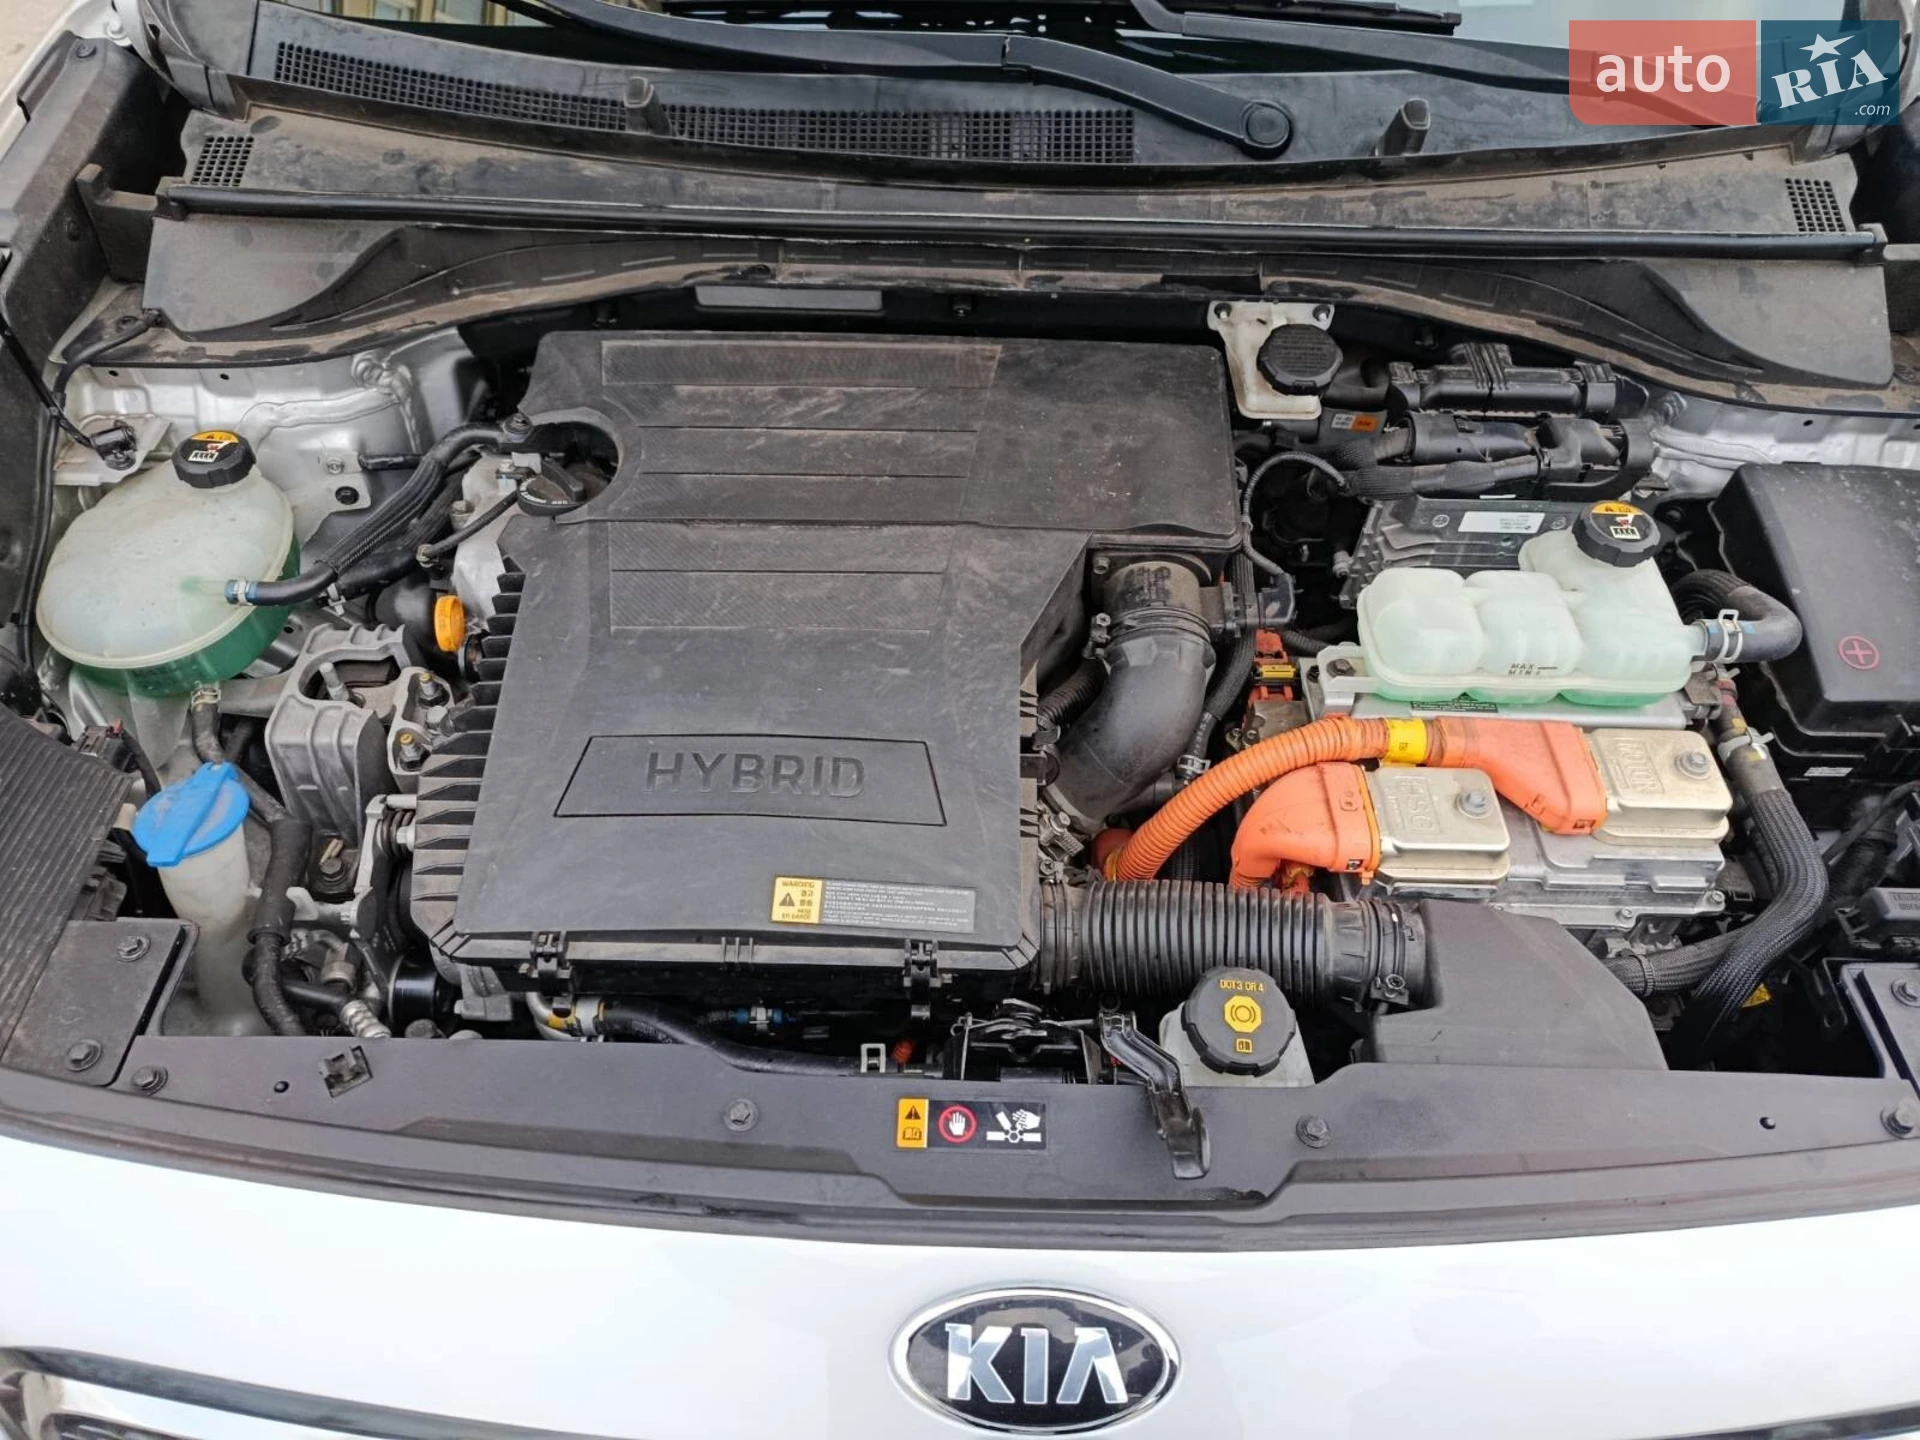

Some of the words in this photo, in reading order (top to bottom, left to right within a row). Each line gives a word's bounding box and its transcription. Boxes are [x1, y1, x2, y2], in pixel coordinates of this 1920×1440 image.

[645, 751, 865, 799] HYBRID
[1257, 983, 1264, 991] 4
[945, 1323, 1129, 1404] KIA
